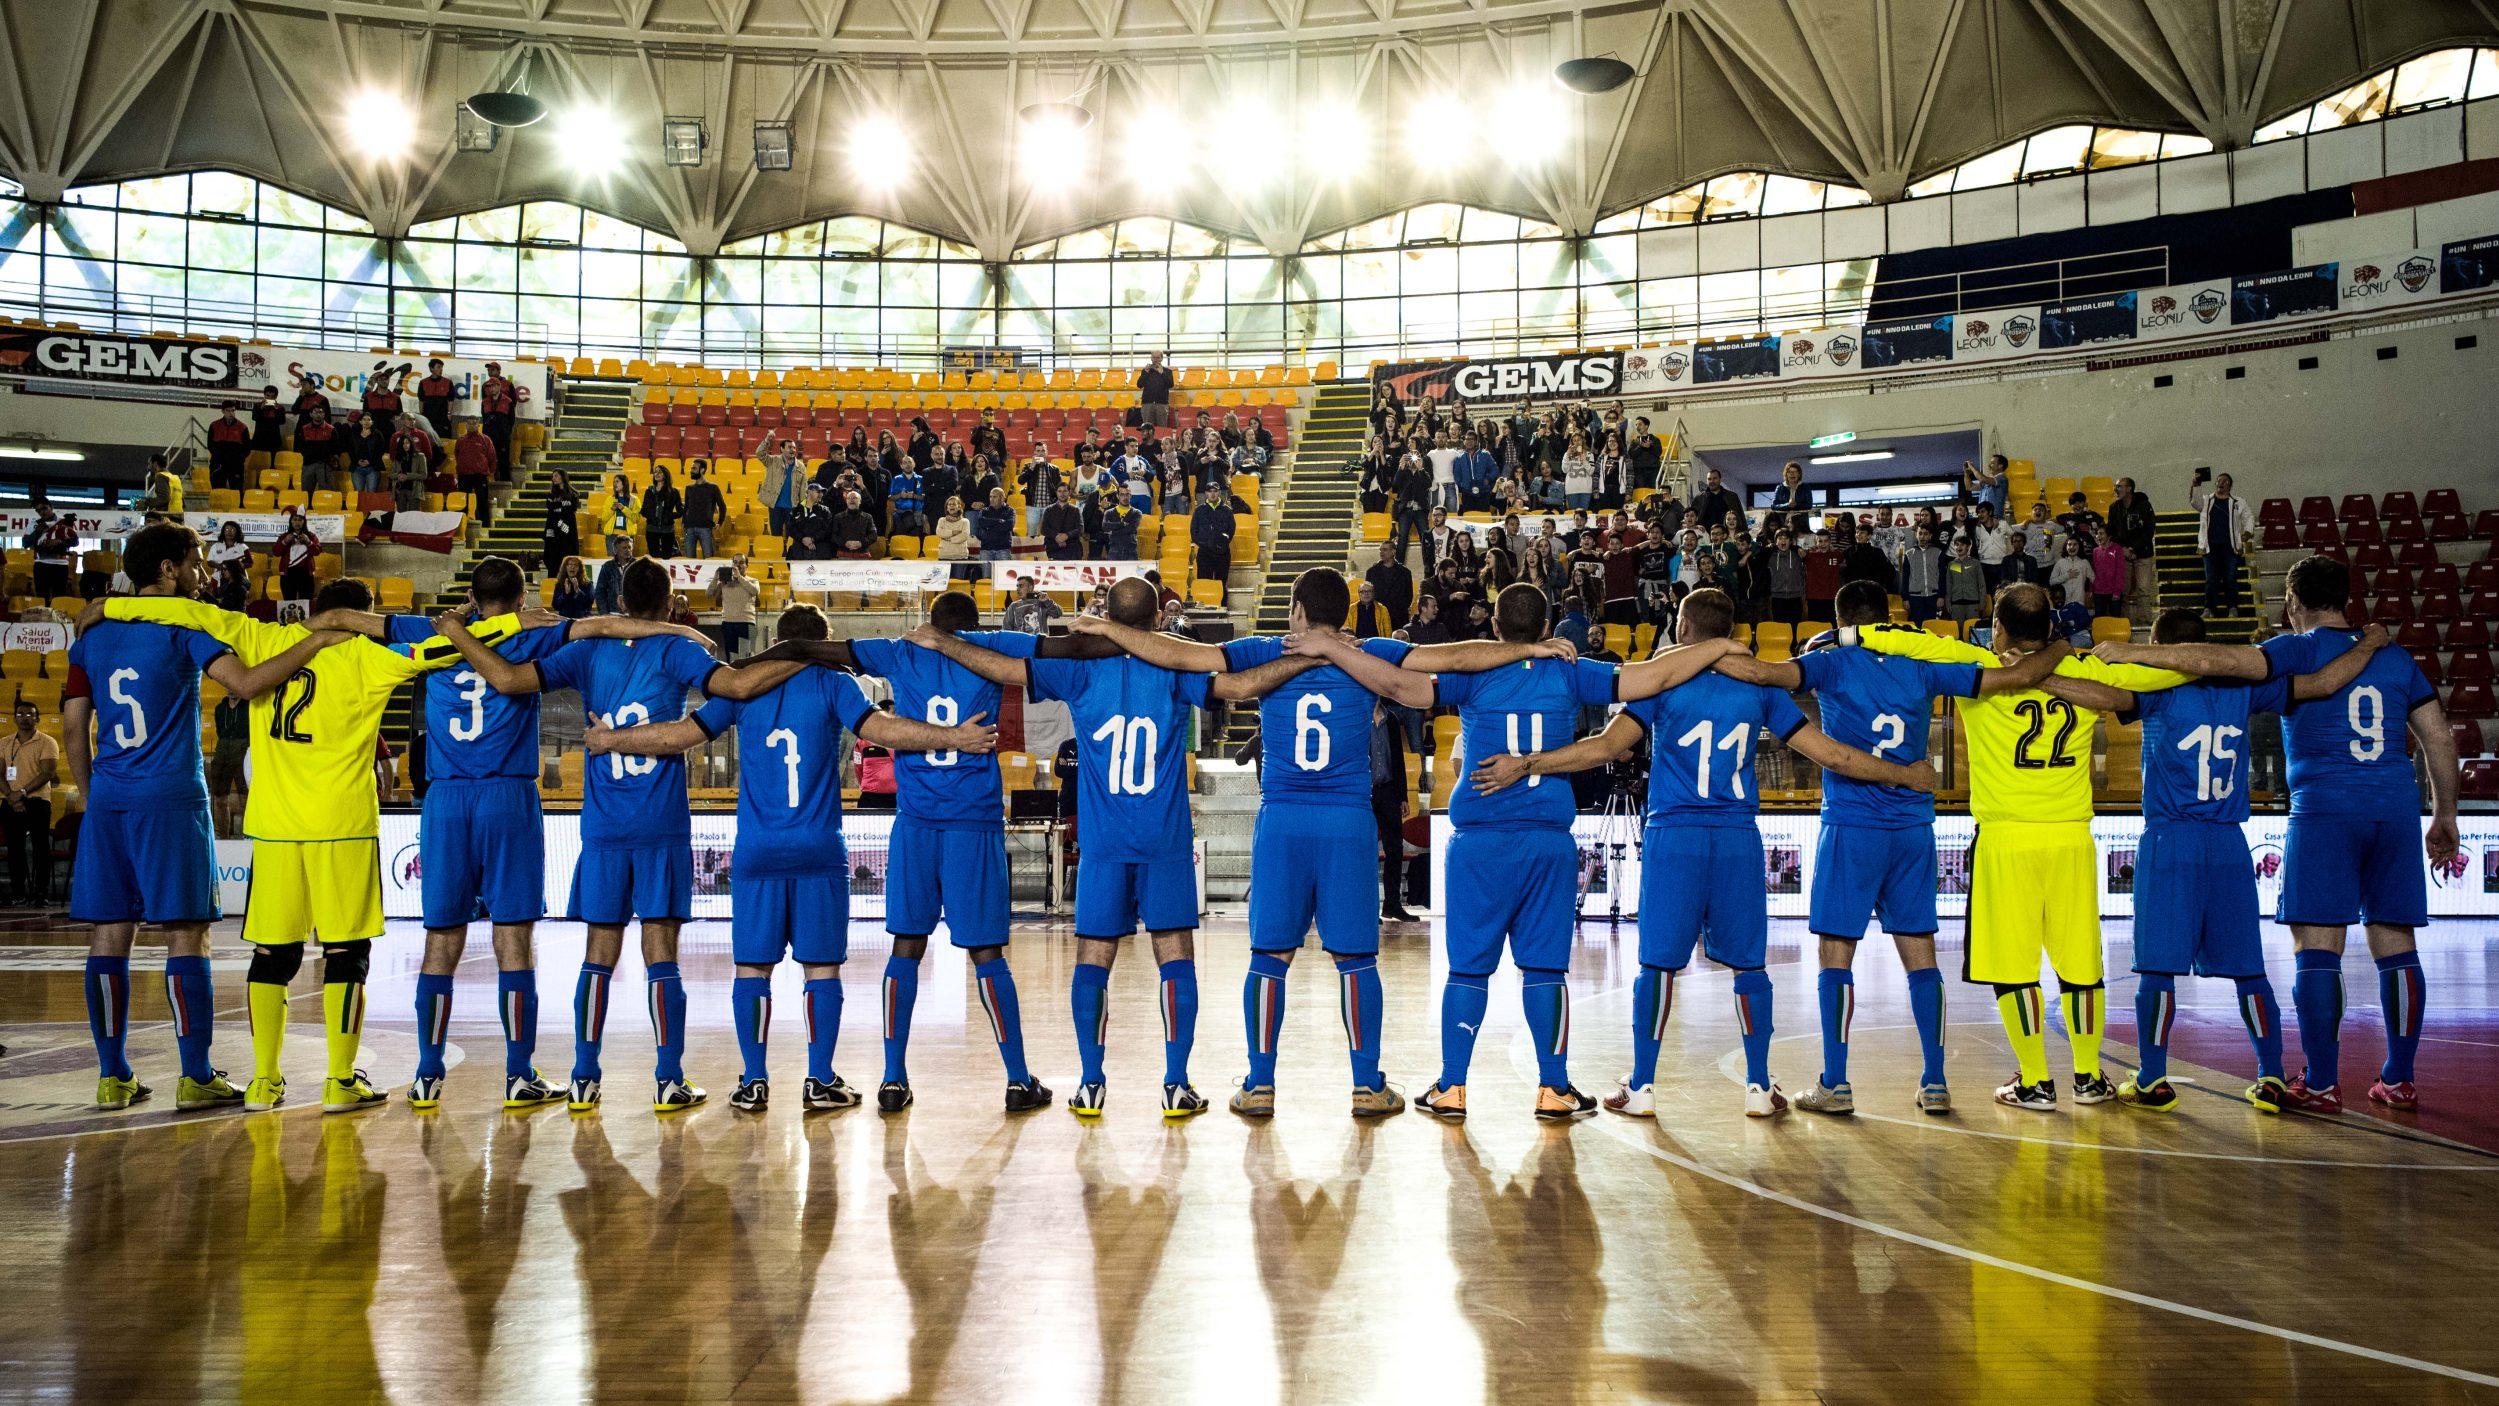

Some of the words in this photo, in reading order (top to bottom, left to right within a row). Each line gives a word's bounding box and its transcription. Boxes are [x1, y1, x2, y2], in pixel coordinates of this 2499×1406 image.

[2289, 271, 2313, 282] LEONI
[2342, 280, 2390, 299] LEONIS
[2093, 300, 2115, 309] LEONI
[1911, 323, 1932, 331] LEONI
[2141, 311, 2186, 329] LEONIS
[1740, 341, 1760, 349] LEONI
[1956, 335, 1998, 350] LEONIS
[36, 336, 229, 382] GEMS
[1783, 353, 1822, 368] LEONIS
[238, 365, 270, 380] EONI
[1454, 350, 1614, 399] GEMS
[1622, 368, 1655, 383] EONIS
[16, 635, 54, 645] Mental
[22, 627, 51, 637] Salud
[108, 667, 148, 750] 5
[269, 666, 318, 744] 12
[448, 670, 487, 742] 3
[925, 694, 959, 767] 8
[1294, 692, 1332, 772] 6
[2347, 684, 2386, 763] 9
[2012, 699, 2078, 769] 22
[1092, 714, 1158, 796] 10
[1677, 719, 1750, 800] 11
[2178, 722, 2244, 802] 15
[765, 727, 801, 808] 7
[863, 832, 889, 841] Giovan
[2264, 832, 2281, 841] Casa
[2470, 832, 2482, 841] Per
